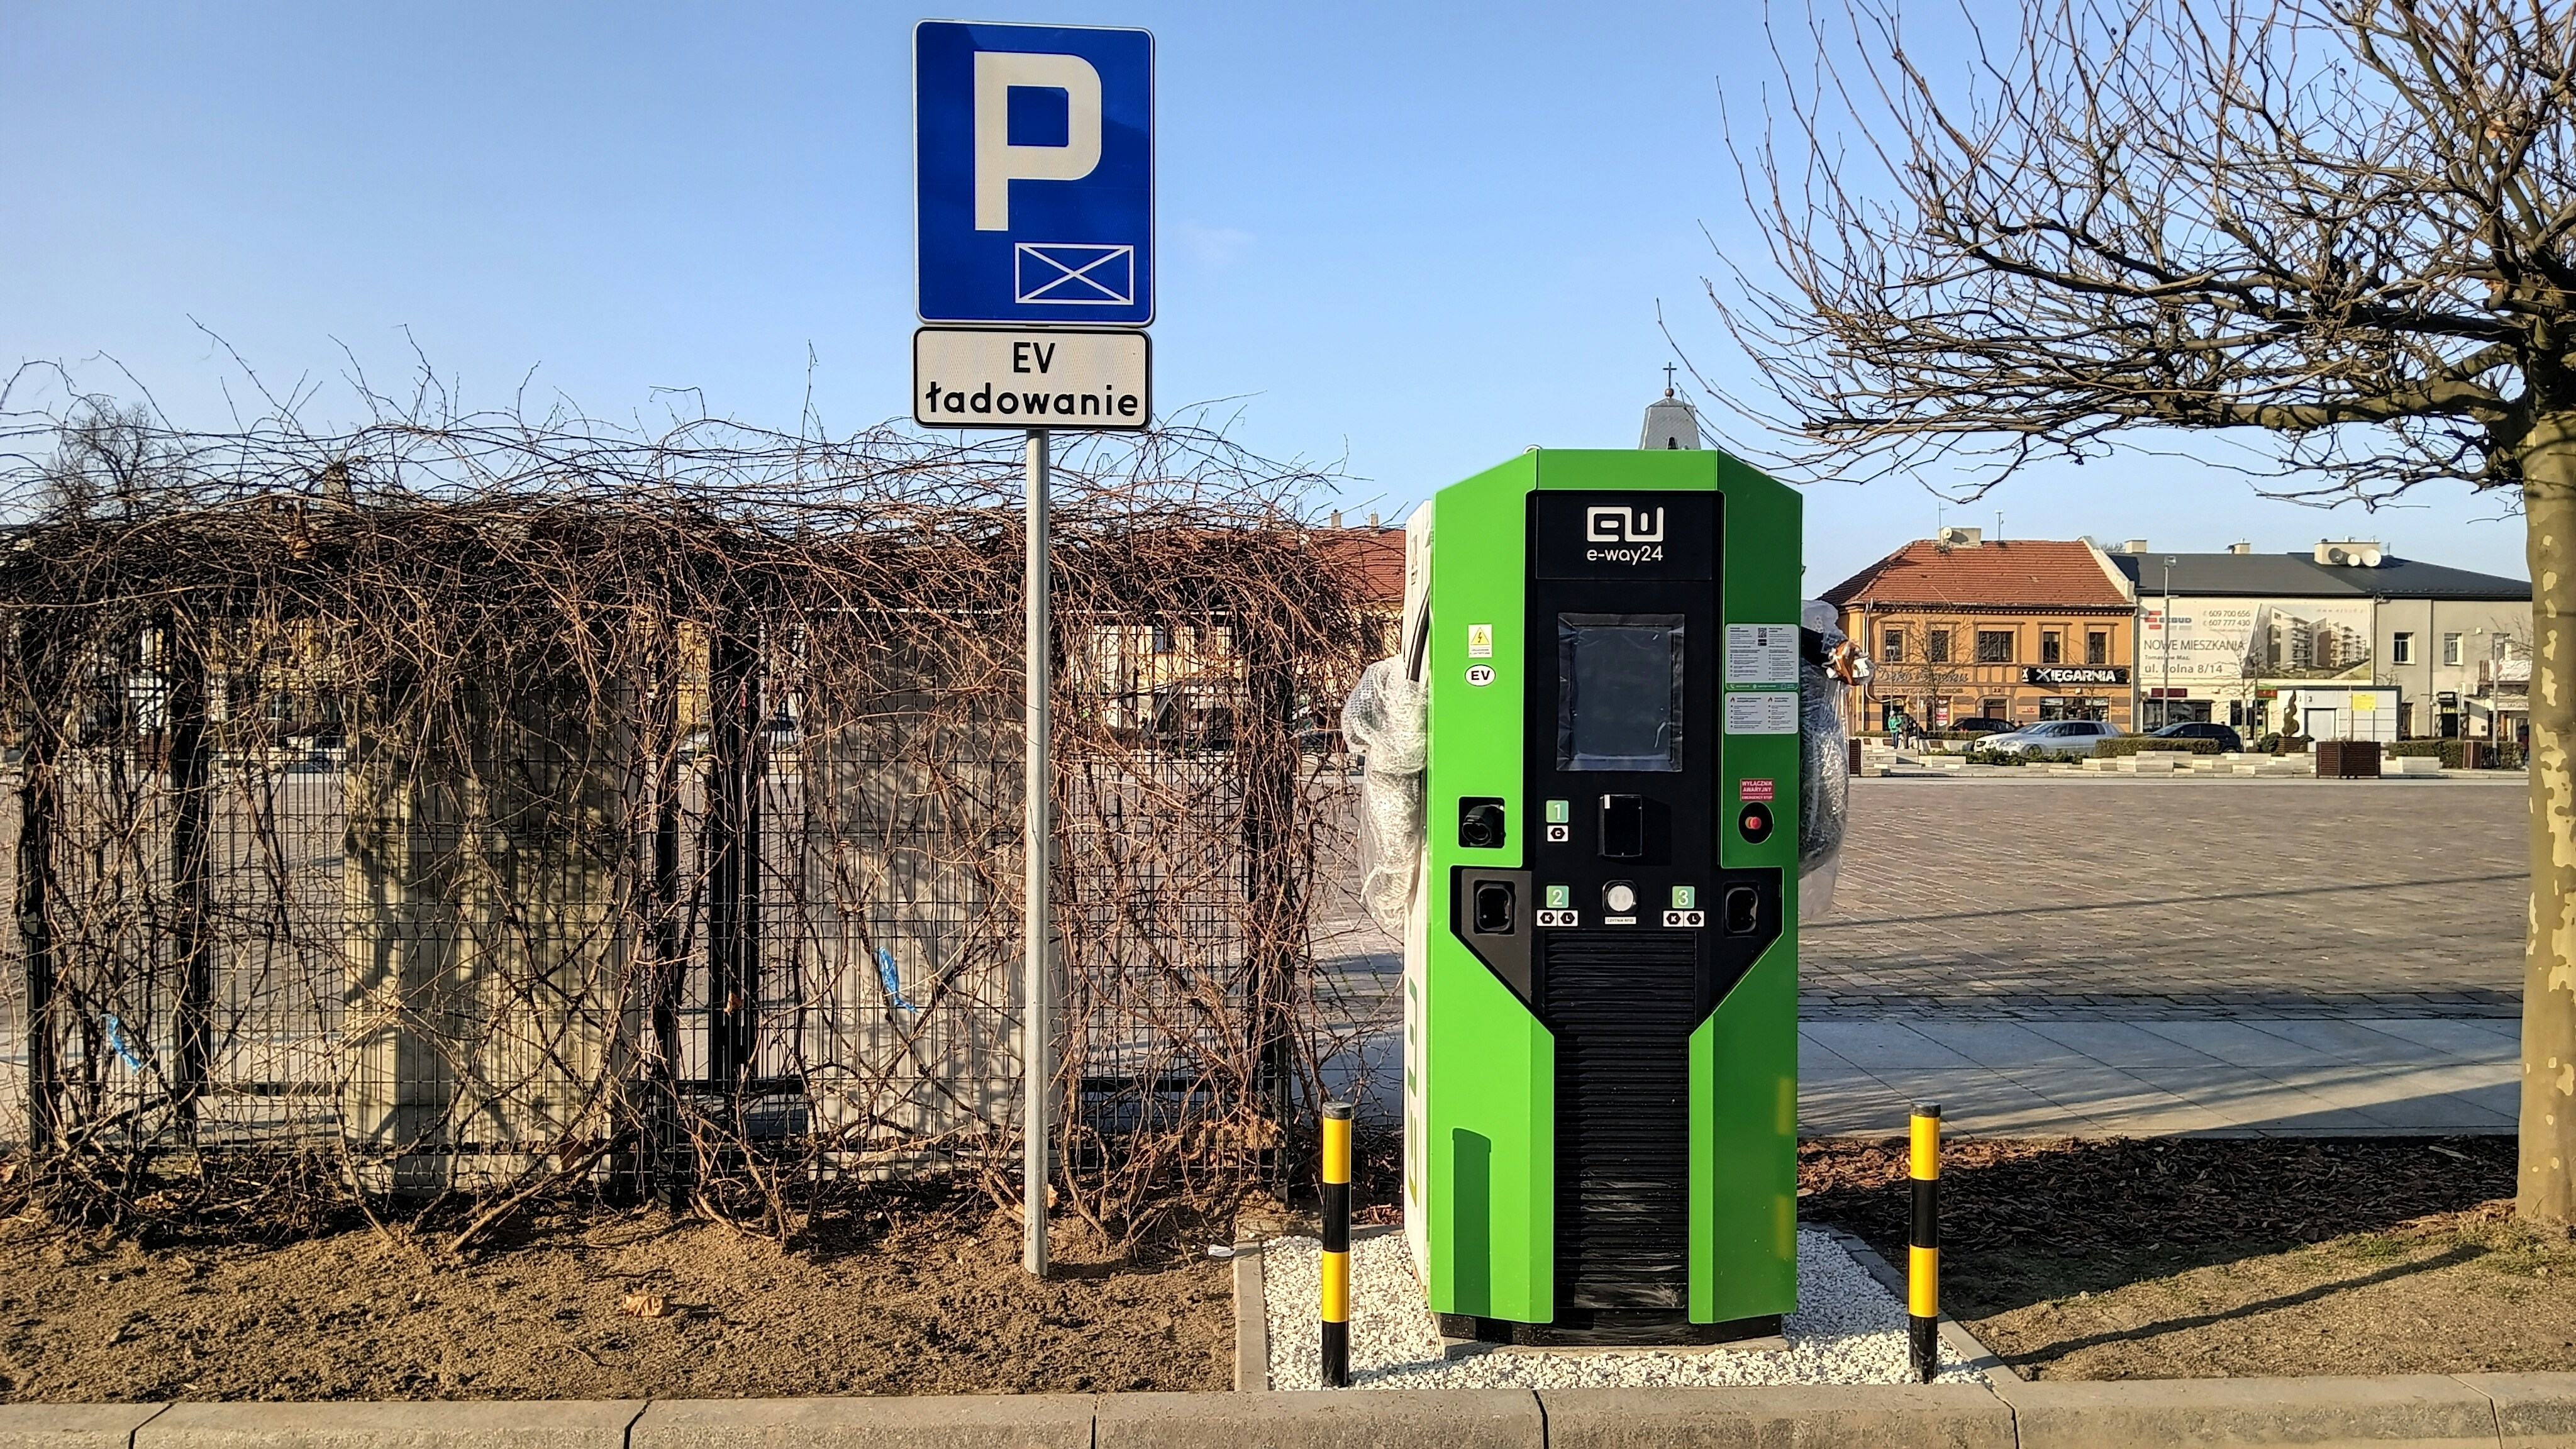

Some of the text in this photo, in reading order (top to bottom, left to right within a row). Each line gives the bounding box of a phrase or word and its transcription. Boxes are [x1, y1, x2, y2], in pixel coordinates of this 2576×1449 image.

[974, 51, 1101, 230] P
[1013, 342, 1055, 374] EV
[926, 381, 1138, 416] ładowanie
[1587, 545, 1663, 565] e-way24
[2180, 640, 2245, 650] MIESZKANIA
[1471, 670, 1490, 680] EV
[2145, 664, 2158, 673] ul.
[2197, 664, 2223, 673] 8/14
[1554, 804, 1560, 819] 1
[1552, 889, 1563, 905] 2
[1678, 890, 1689, 906] 3
